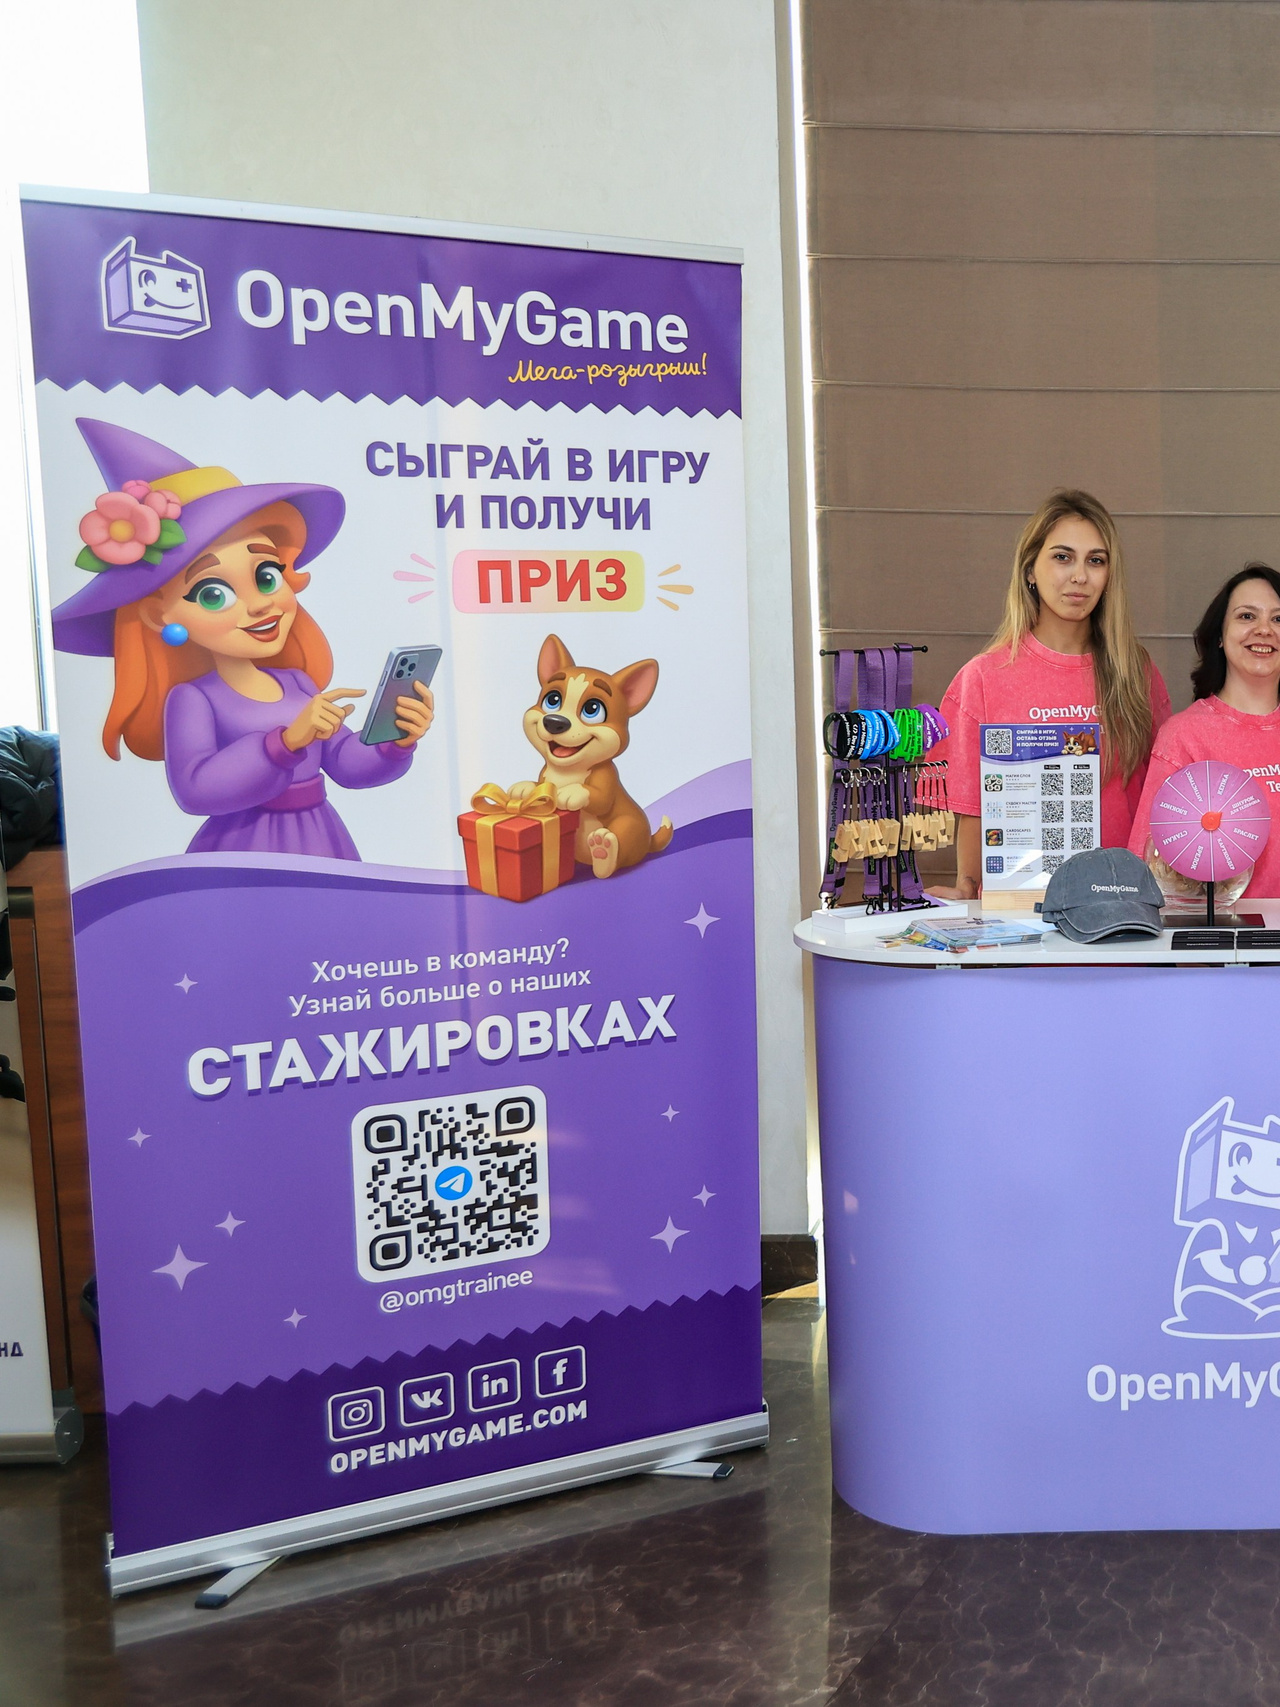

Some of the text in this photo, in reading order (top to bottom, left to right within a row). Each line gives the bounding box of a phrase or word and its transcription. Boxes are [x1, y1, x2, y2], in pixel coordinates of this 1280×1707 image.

[236, 269, 690, 355] OpenMyGame
[508, 353, 708, 387] Мега-розыгрыш!
[365, 438, 710, 486] СЫГРАЙ В ИГРУ
[435, 494, 652, 531] И ПОЛУЧИ
[476, 559, 627, 604] ПРИЗ
[1029, 705, 1102, 721] OpenMyG
[1185, 771, 1203, 802] АНТИСТРЕСС
[1217, 774, 1229, 795] КЕПКА
[830, 788, 839, 832] OpenMyGame
[1160, 801, 1188, 815] БЛОКНОТ
[1163, 830, 1188, 845] СТАКАН
[1233, 828, 1259, 840] БРАСЛЕТ
[1091, 883, 1139, 893] OpenMyGame
[312, 937, 570, 984] Хочешь в команду?
[289, 967, 591, 1018] Узнай больше о наших
[187, 994, 677, 1097] СТАЖИРОВКАХ
[379, 1267, 534, 1313] @omgtrainee
[330, 1400, 588, 1474] OPENMYGAME.COM
